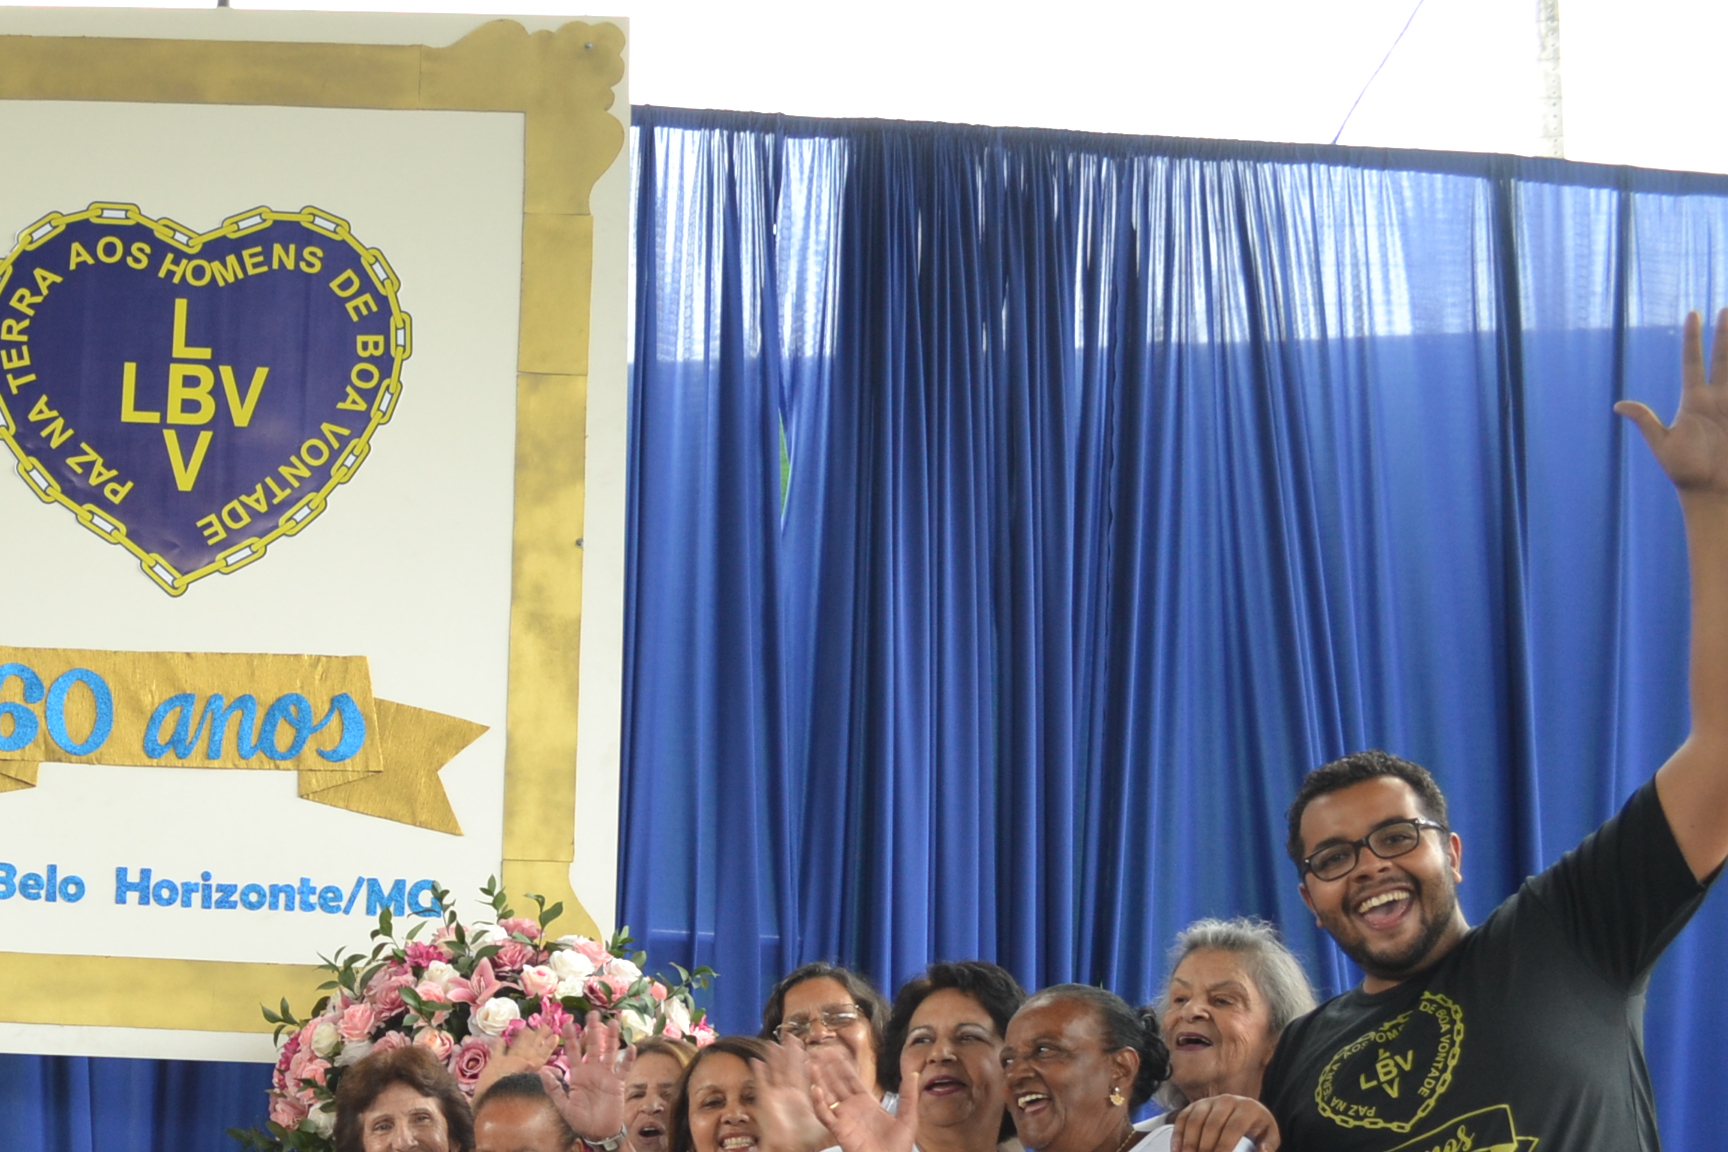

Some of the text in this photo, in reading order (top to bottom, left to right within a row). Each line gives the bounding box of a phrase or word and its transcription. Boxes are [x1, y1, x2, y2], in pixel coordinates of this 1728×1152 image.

[0, 236, 385, 546] PAZ NA TERRA AOS HOMENS DE BOA VONTADE
[121, 362, 269, 428] LBV
[142, 691, 366, 762] anos
[114, 865, 443, 918] Horizonte/MG
[1359, 1050, 1413, 1090] LBV
[1418, 1001, 1451, 1097] DE BOA VONTADE
[1330, 1096, 1347, 1112] NA
[1347, 1104, 1376, 1117] PAZ
